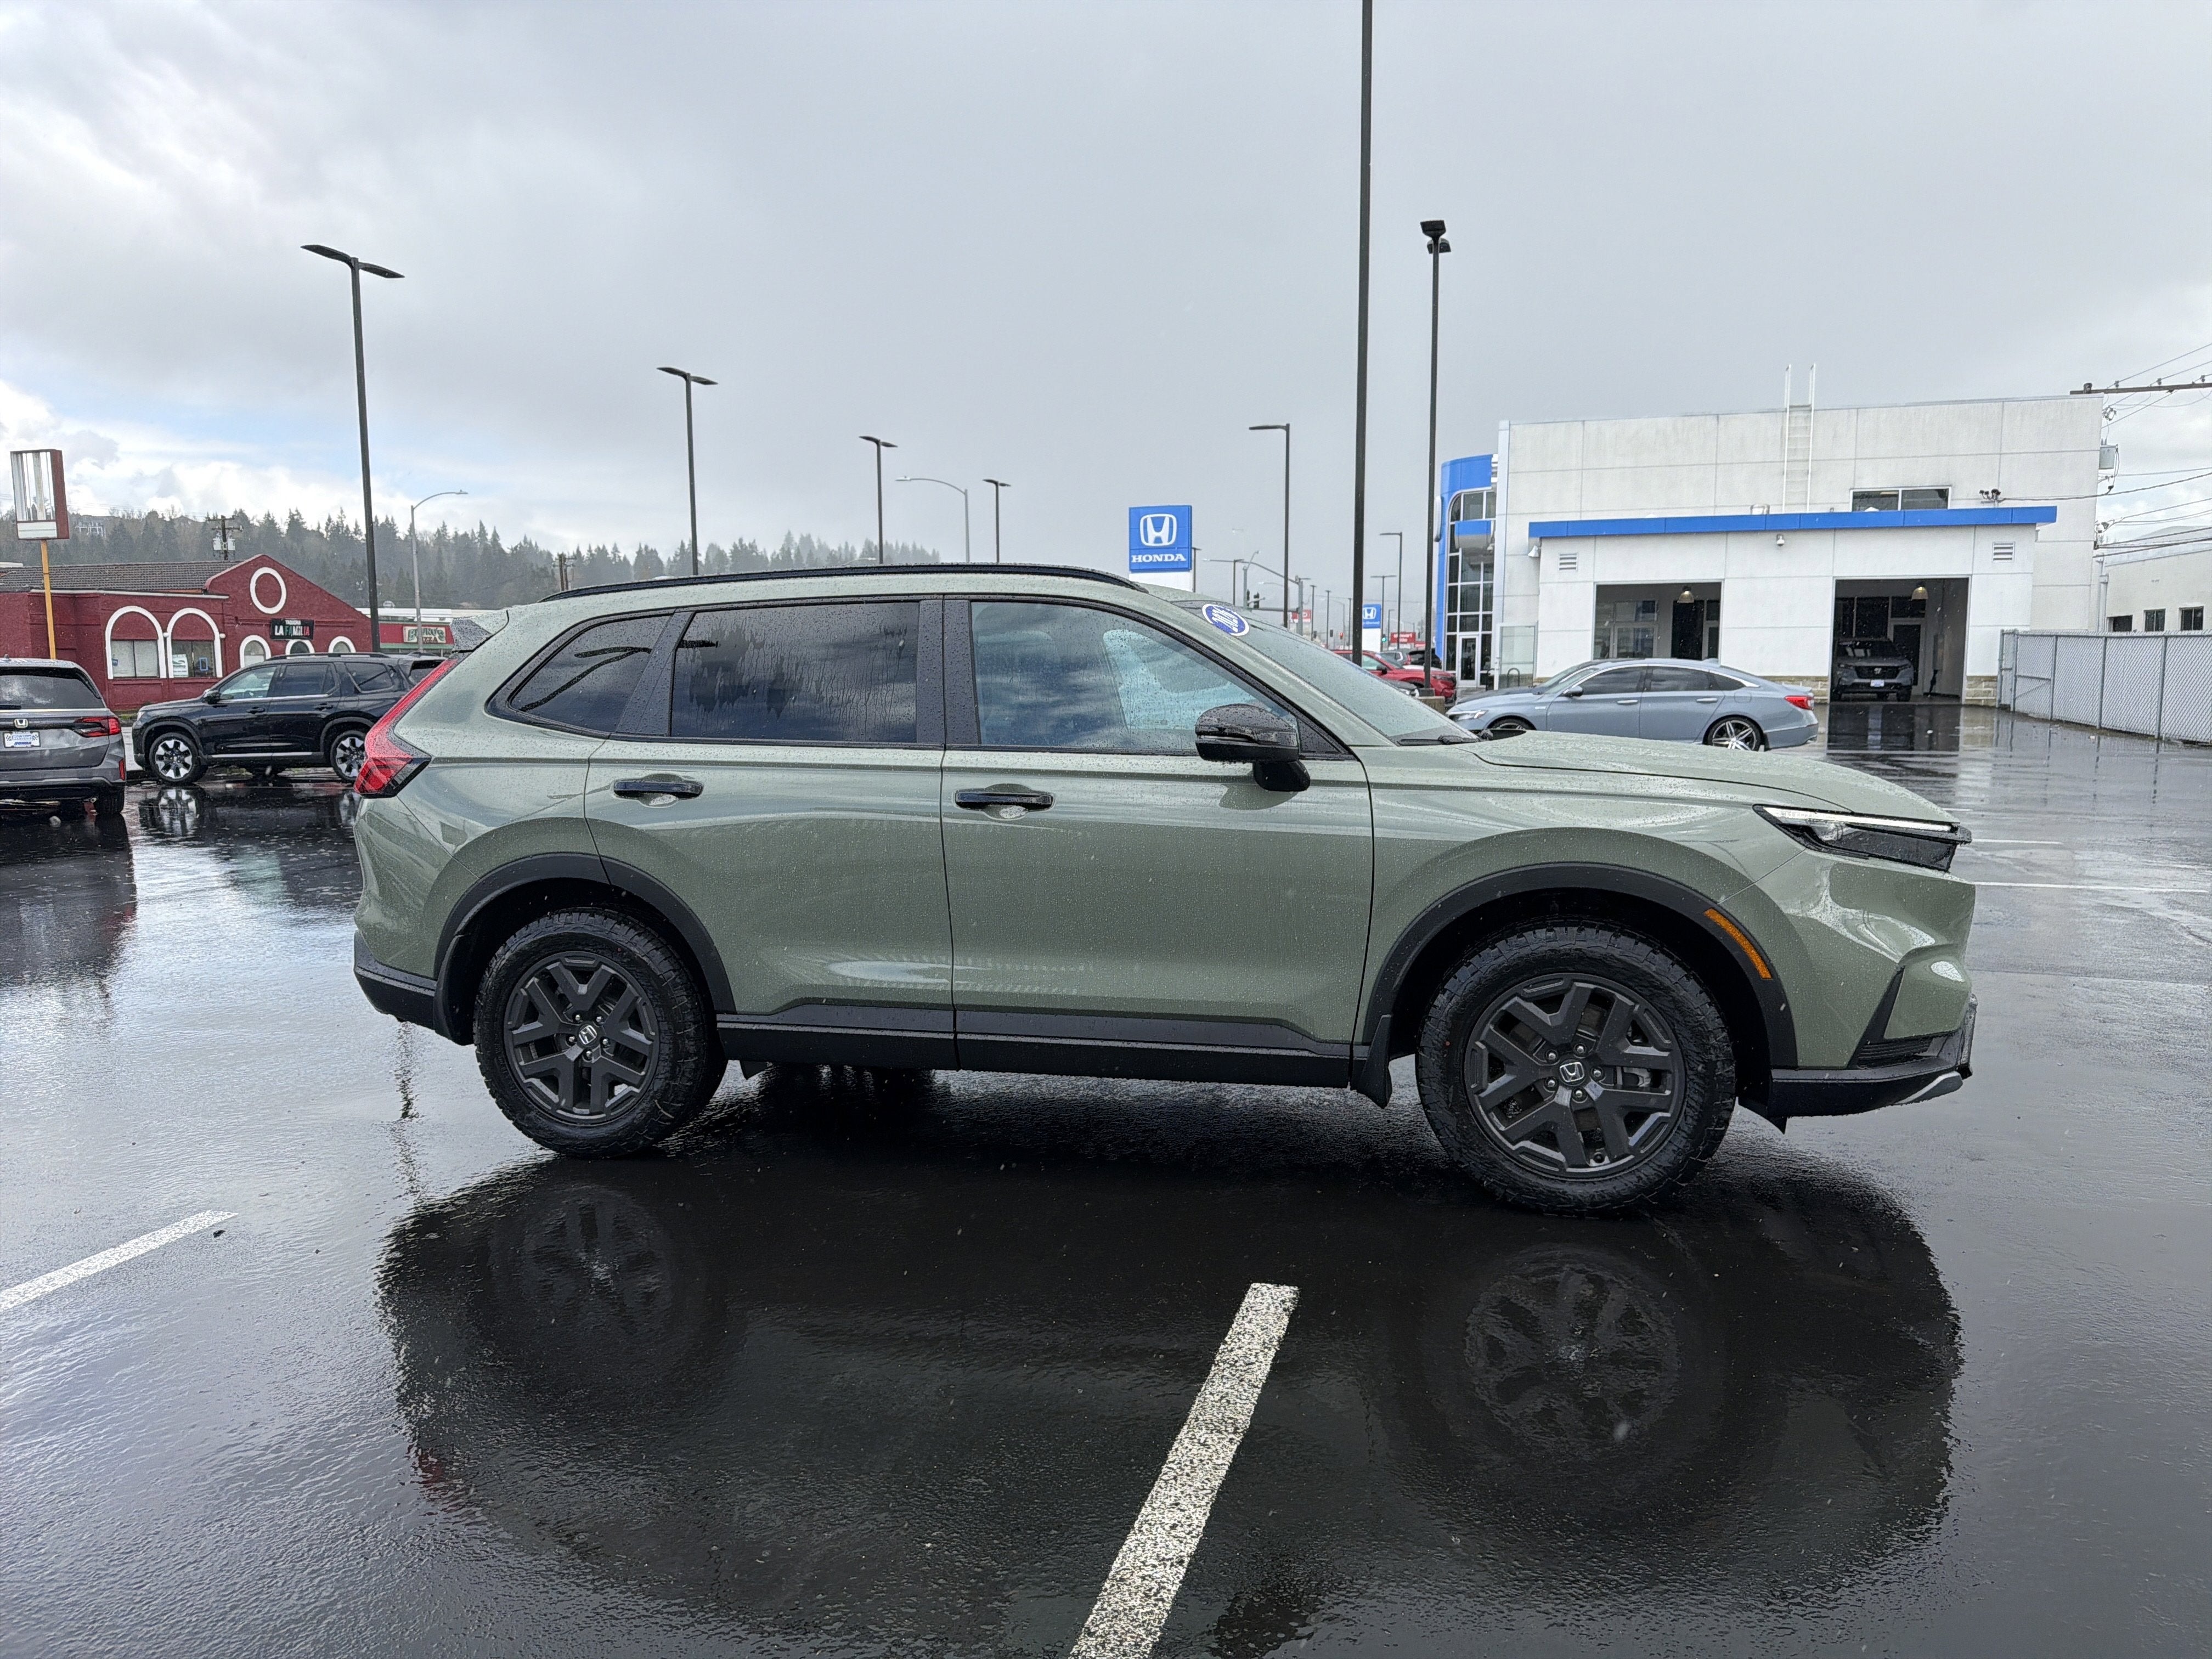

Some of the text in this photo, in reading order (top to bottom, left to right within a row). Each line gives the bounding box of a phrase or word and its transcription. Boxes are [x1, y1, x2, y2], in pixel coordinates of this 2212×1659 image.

[1131, 554, 1186, 562] HONDA
[275, 625, 310, 636] LA FAMILIA
